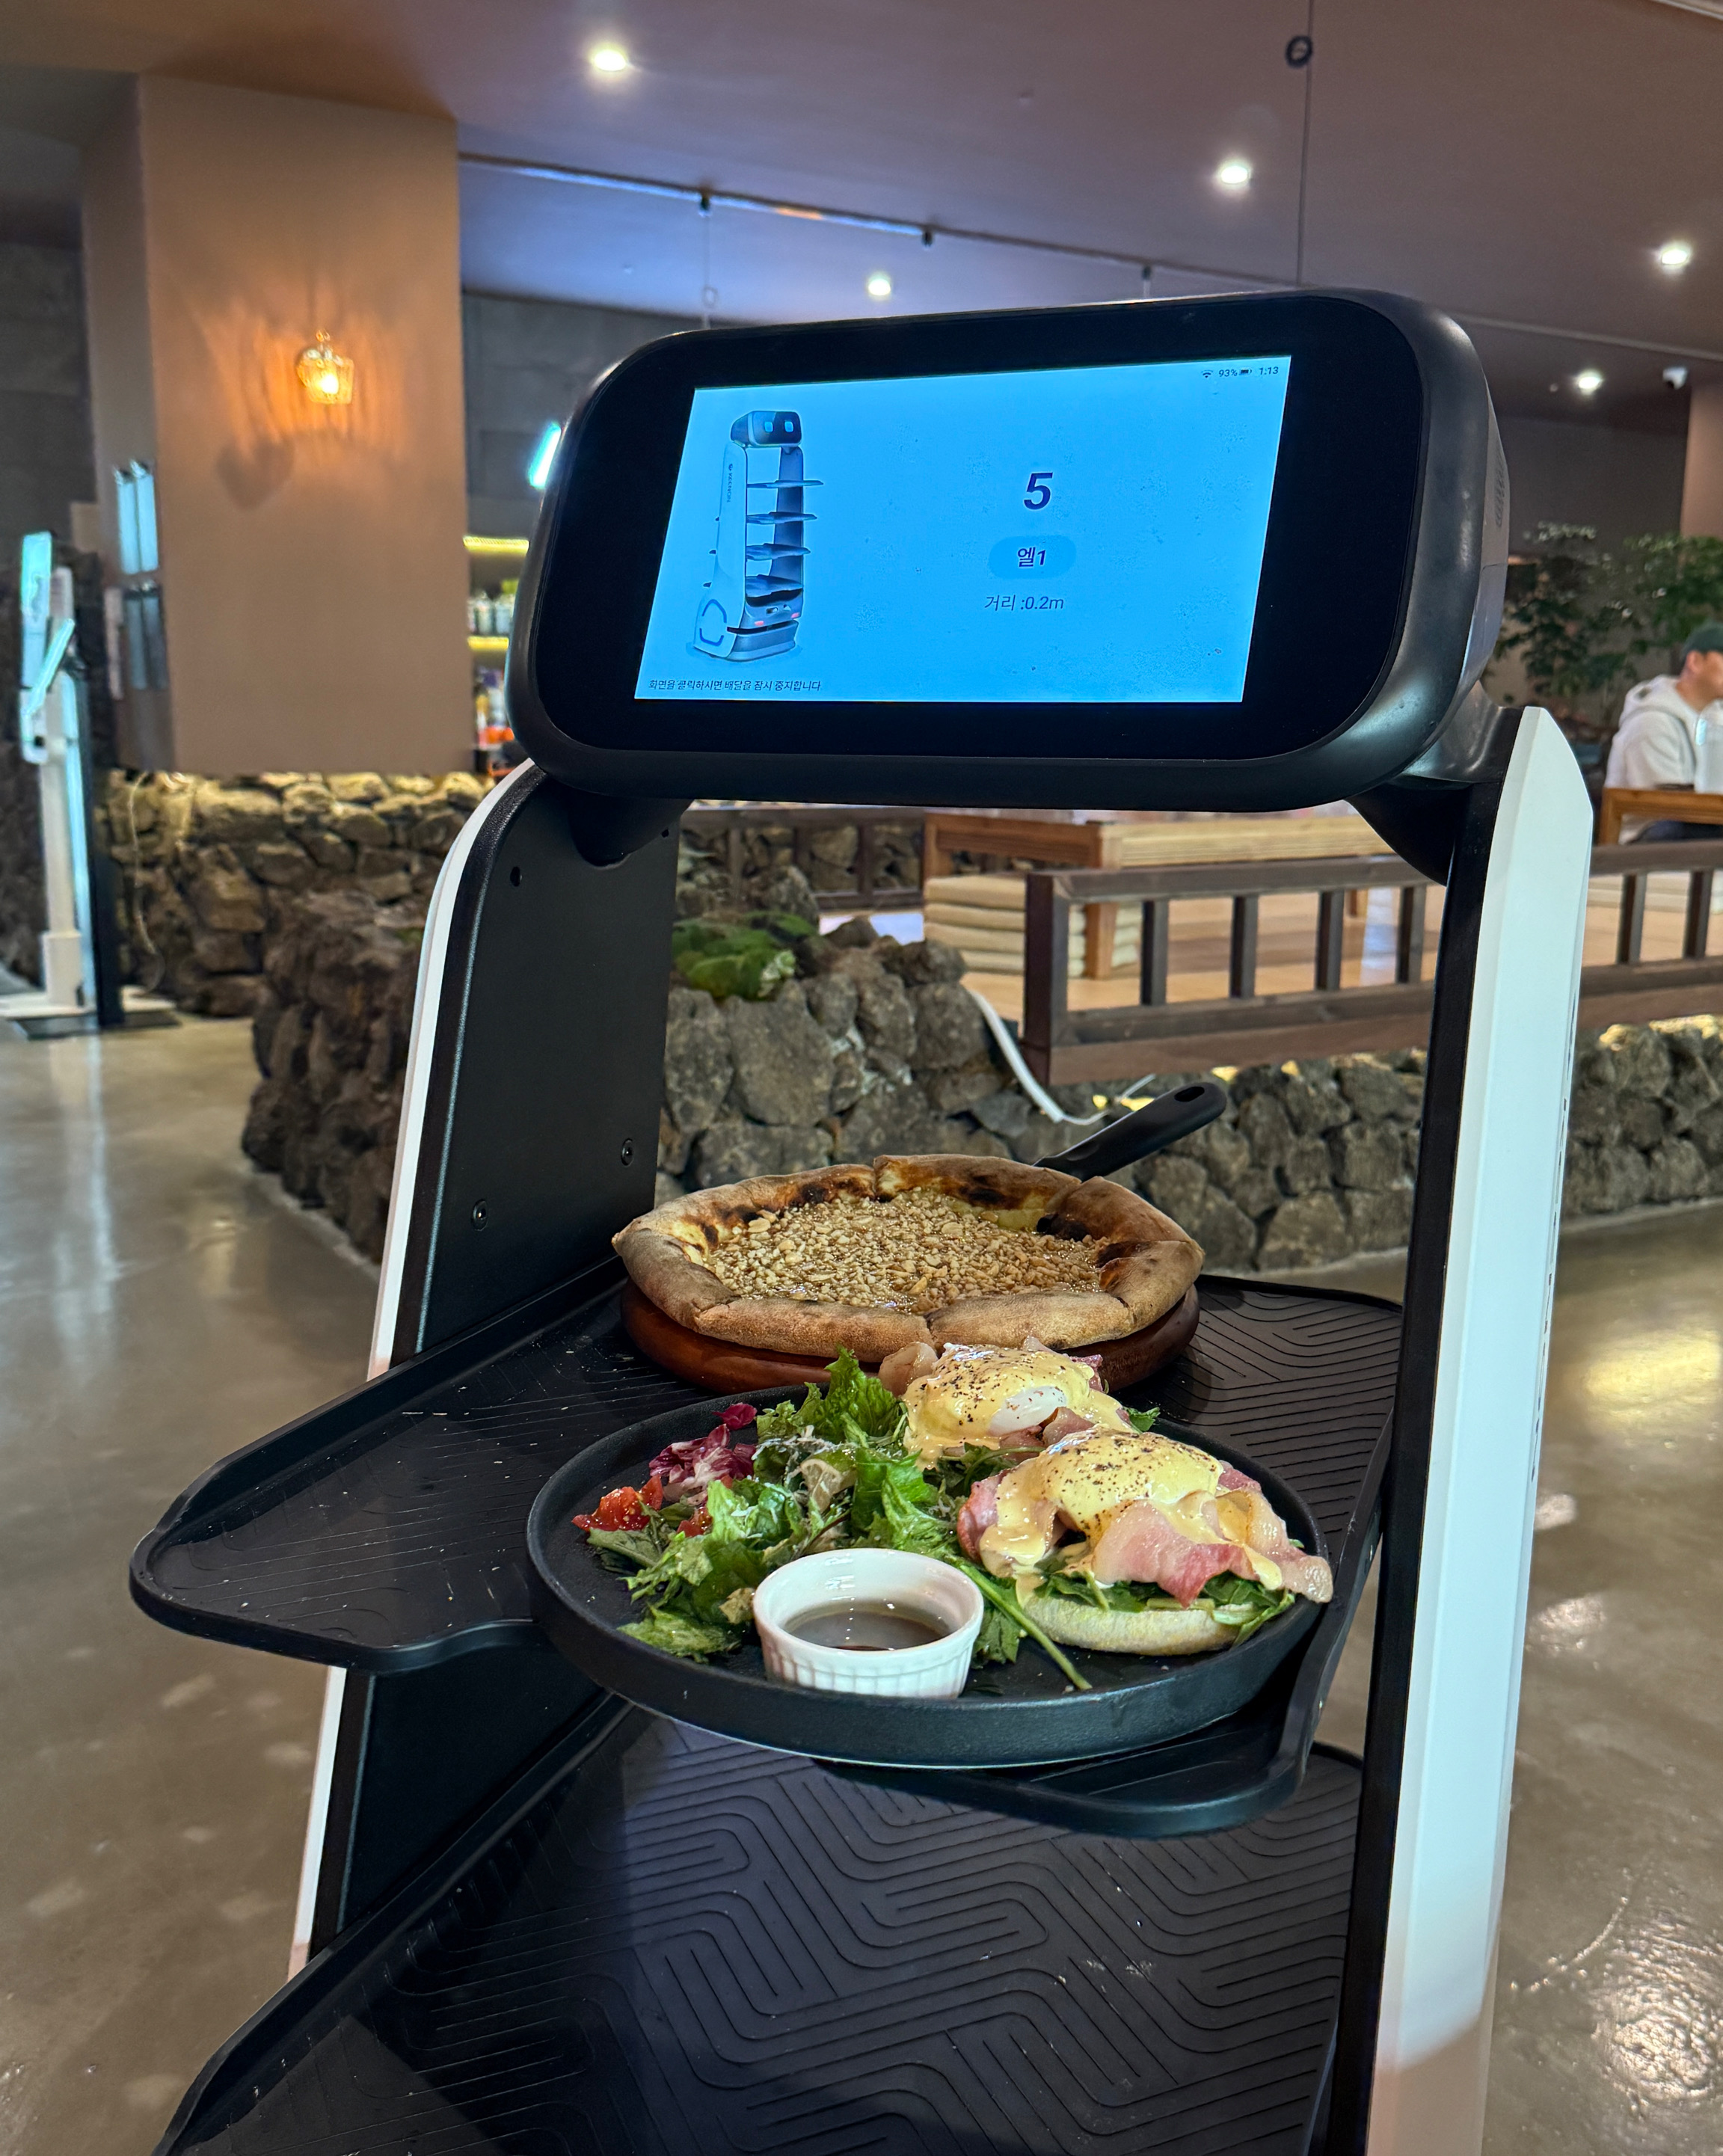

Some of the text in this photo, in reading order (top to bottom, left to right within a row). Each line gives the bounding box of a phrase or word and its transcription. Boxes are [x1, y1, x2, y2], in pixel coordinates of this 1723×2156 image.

[1218, 366, 1279, 378] 93% 1:13
[1023, 472, 1054, 511] 5
[1017, 547, 1046, 568] 엘1
[984, 594, 1065, 611] 거리 :0.2m
[648, 679, 675, 690] 화면을
[754, 680, 773, 692] 잠시
